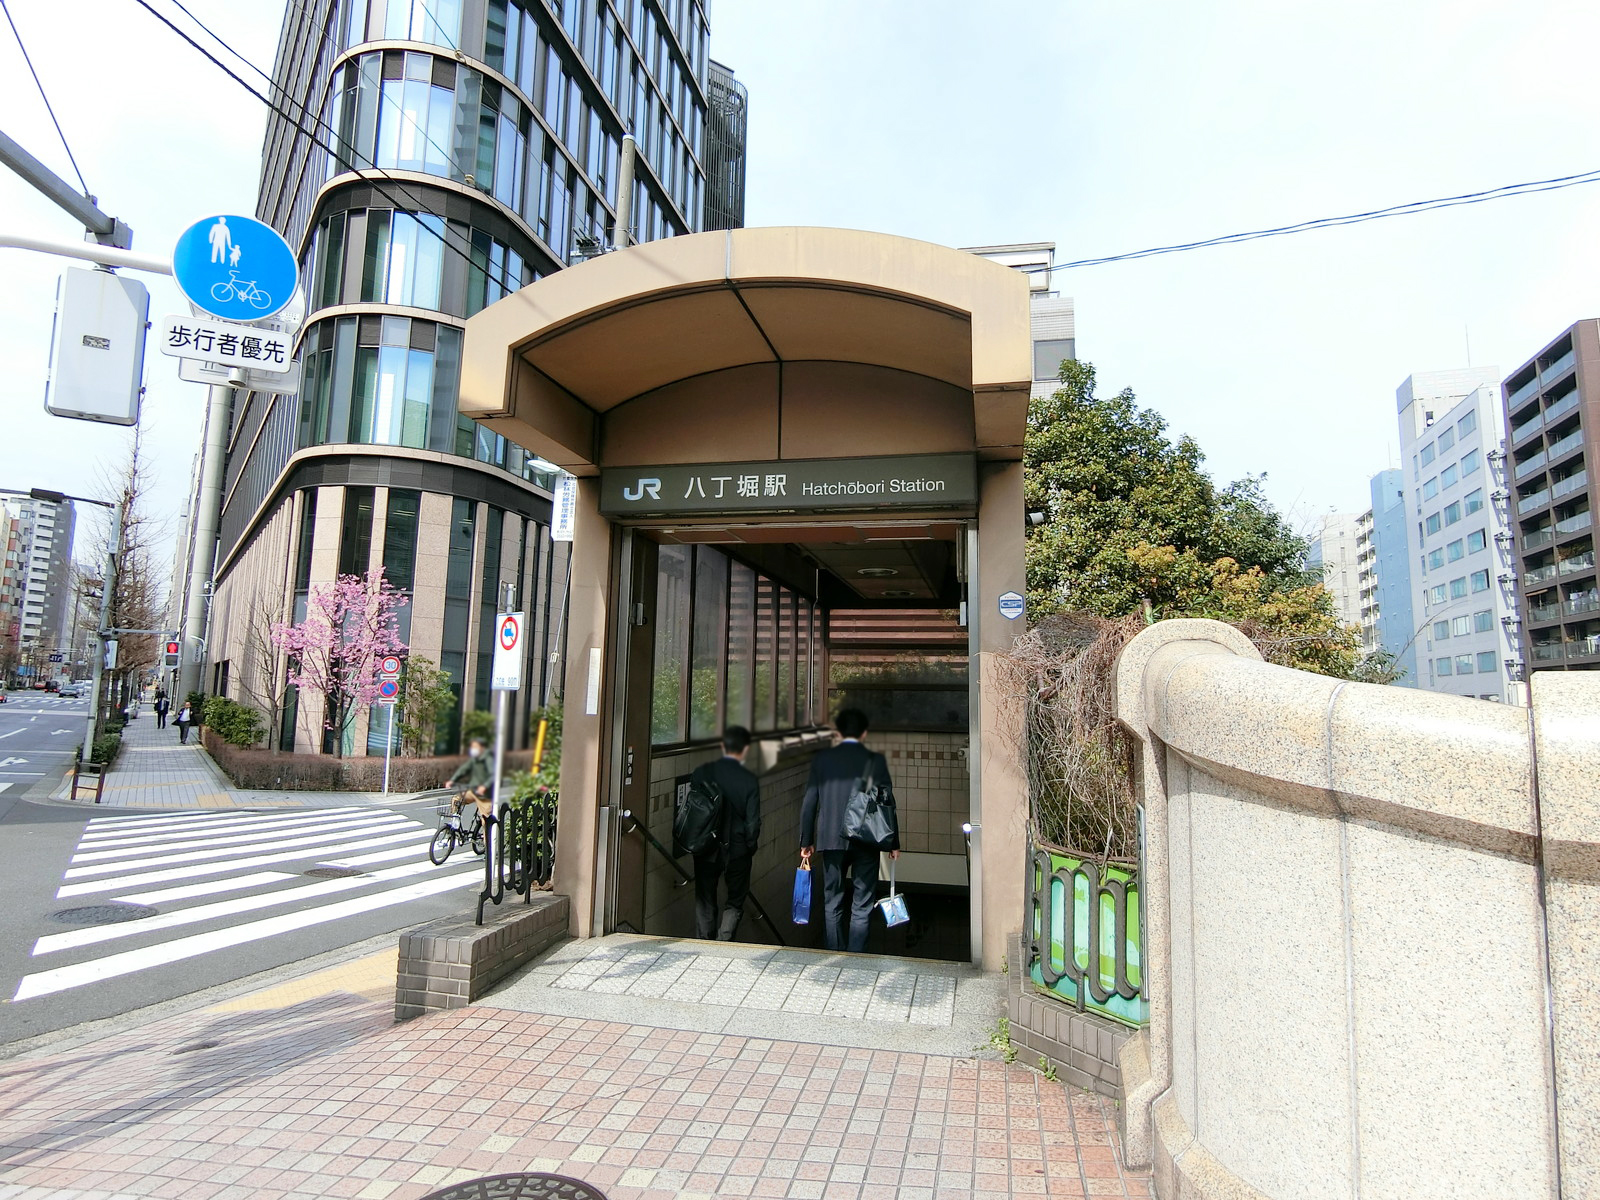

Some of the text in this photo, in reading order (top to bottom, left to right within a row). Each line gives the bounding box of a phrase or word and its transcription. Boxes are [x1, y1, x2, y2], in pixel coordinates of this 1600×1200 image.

[169, 325, 285, 363] 歩行者優先
[623, 474, 945, 501] JR 八丁堀駅 Hatchōbori Station
[385, 661, 397, 670] 30
